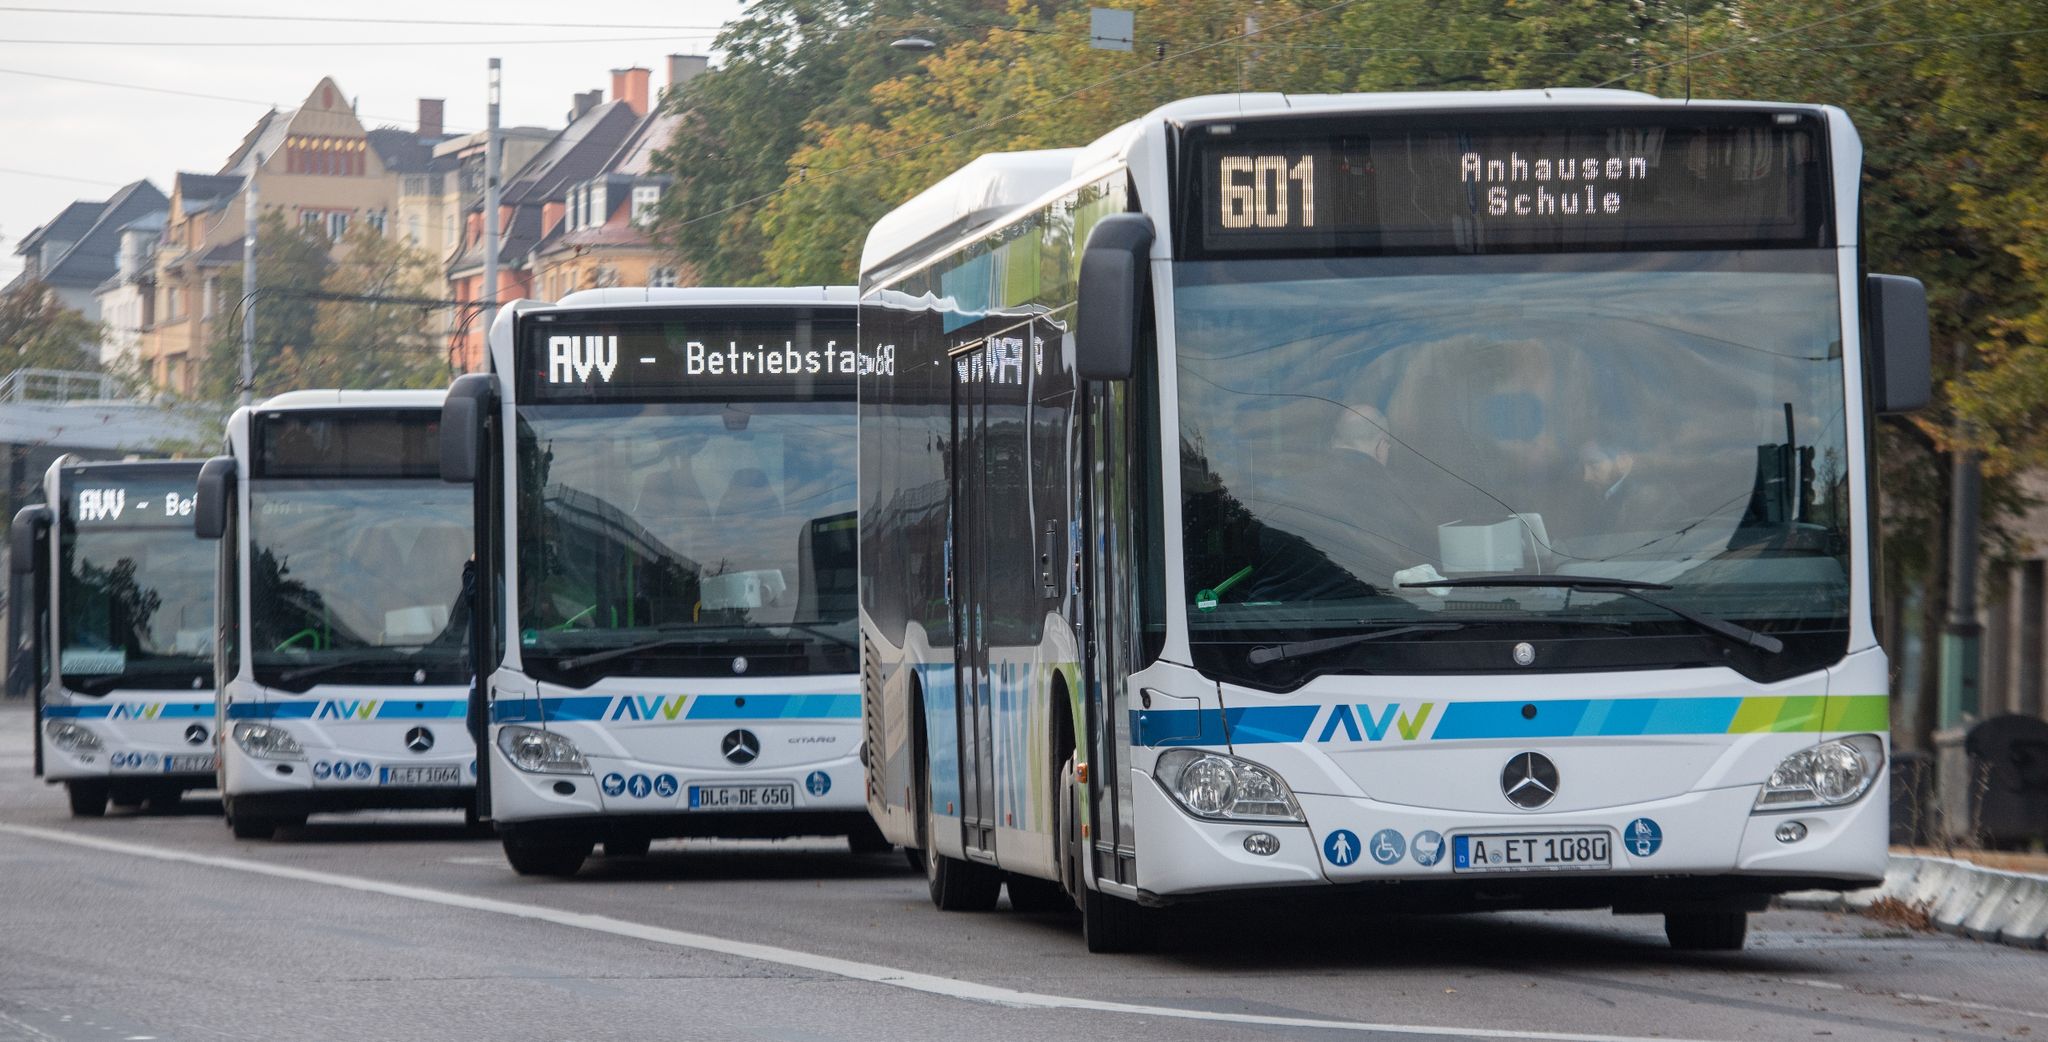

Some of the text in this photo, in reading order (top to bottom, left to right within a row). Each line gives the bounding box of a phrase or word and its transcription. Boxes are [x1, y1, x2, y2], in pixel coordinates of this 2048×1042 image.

[1221, 152, 1647, 228] 601 Anhausen
[1488, 185, 1620, 216] Schule
[549, 335, 618, 383] AVV
[79, 488, 126, 520] AVV
[318, 701, 377, 720] AVV
[609, 694, 689, 721] AVV
[1317, 703, 1435, 742] AVV
[389, 768, 397, 782] A
[407, 767, 422, 782] ET
[701, 788, 789, 806] DLG DE 650
[1473, 841, 1488, 864] A
[1506, 840, 1537, 863] ET
[1544, 837, 1607, 862] 1080
